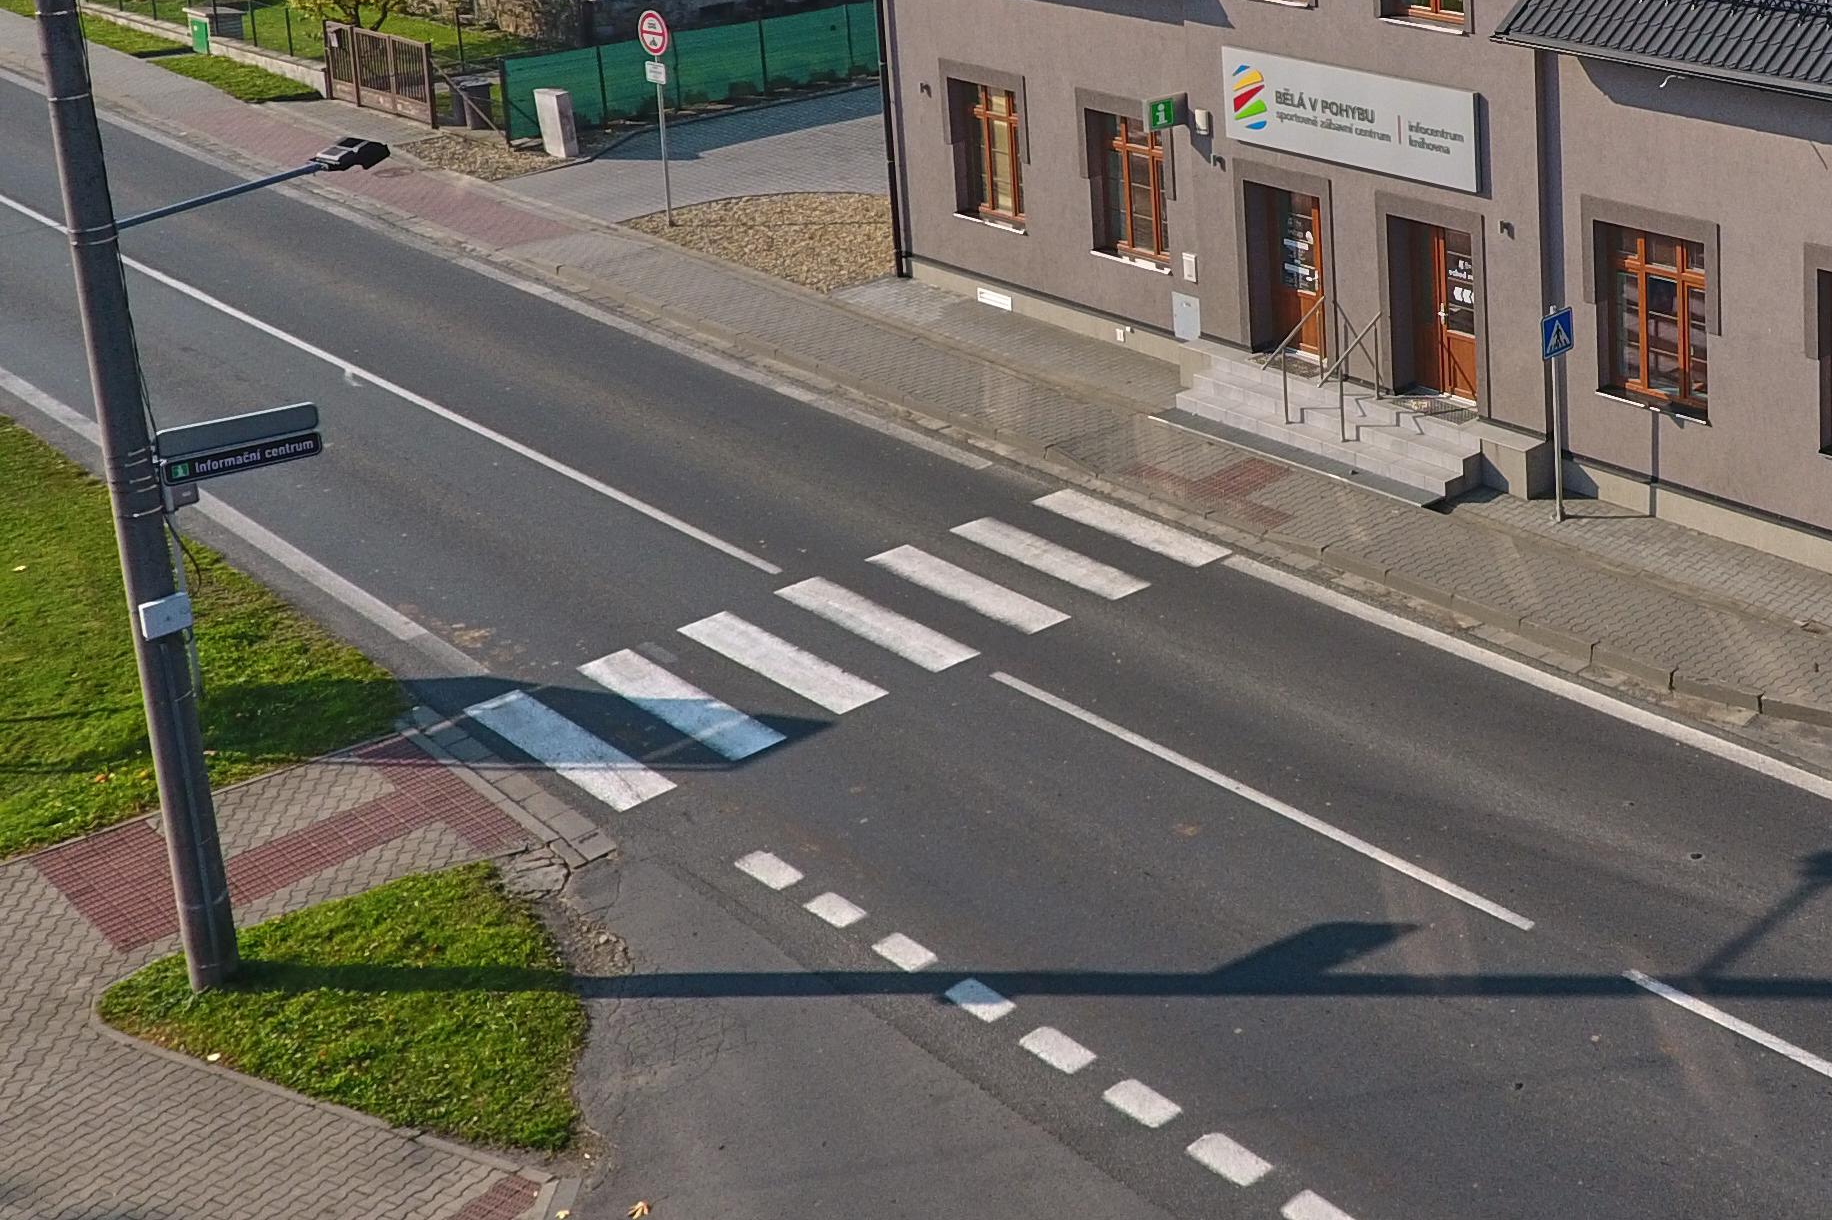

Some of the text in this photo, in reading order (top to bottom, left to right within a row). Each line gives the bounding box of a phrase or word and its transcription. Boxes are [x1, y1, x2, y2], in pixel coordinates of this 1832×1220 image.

[1275, 88, 1375, 123] BĚLÁ V POHYBU
[1354, 127, 1392, 142] centrum
[1408, 121, 1464, 143] infocentrum
[1408, 135, 1451, 155] knihovna
[195, 440, 314, 473] Informační centrum
